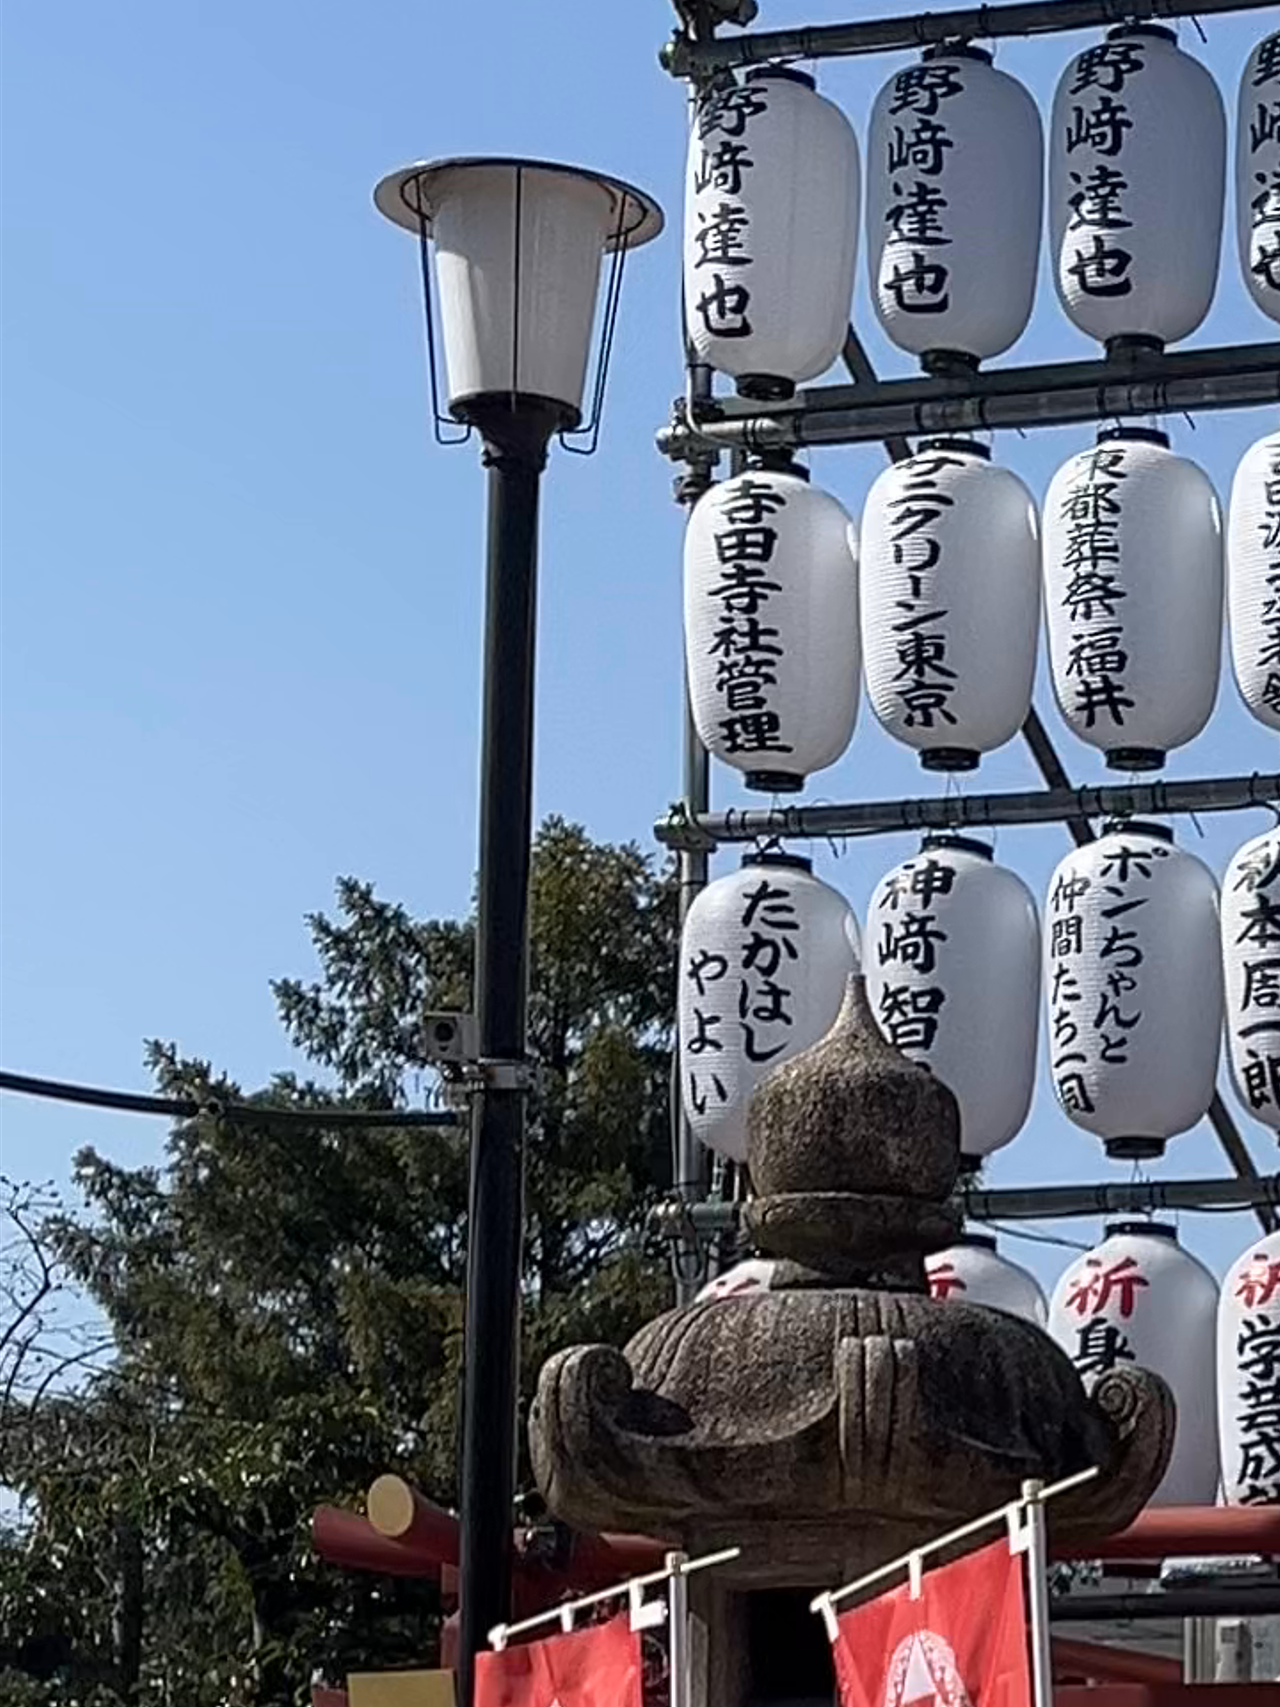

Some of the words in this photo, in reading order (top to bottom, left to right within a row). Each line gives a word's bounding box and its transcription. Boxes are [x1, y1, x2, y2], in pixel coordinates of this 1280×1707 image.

[708, 480, 794, 754] 寺田寺社管理
[686, 950, 729, 1116] やよい
[739, 881, 800, 1062] たかはし
[1050, 867, 1097, 1116] 仲間たち一同
[1092, 845, 1170, 1064] ポンちゃんと
